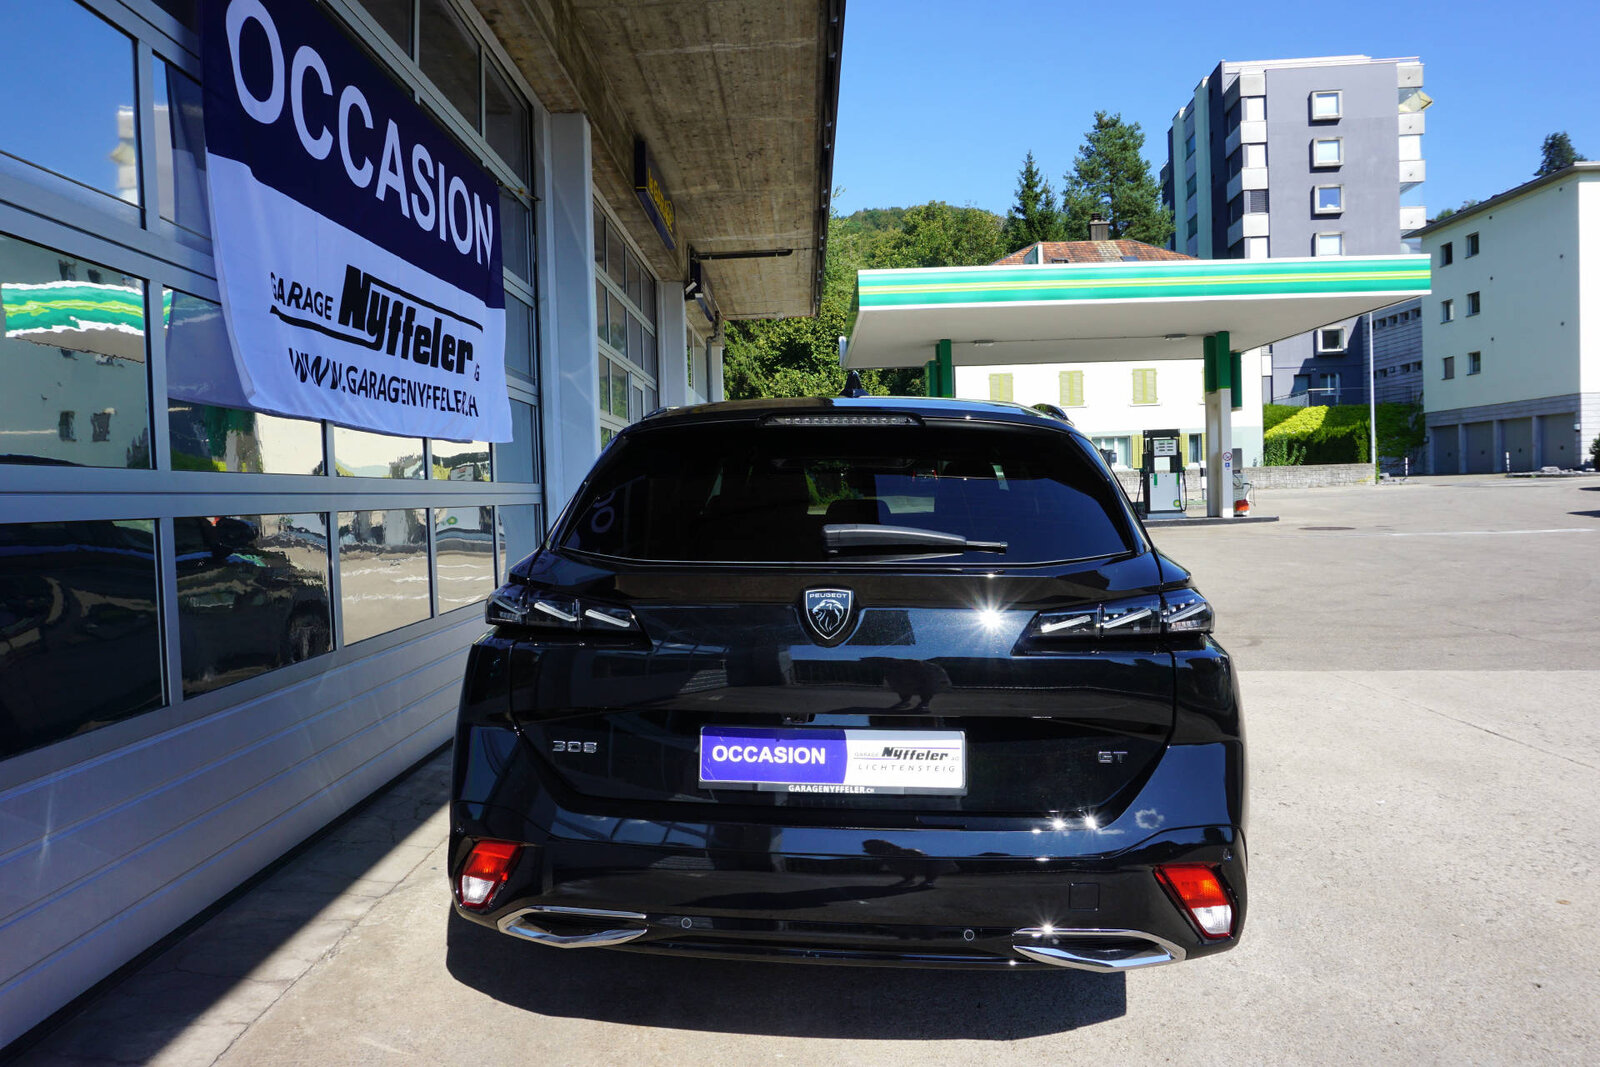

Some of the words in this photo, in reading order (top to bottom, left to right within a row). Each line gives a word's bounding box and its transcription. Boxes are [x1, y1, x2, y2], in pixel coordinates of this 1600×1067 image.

[225, 0, 494, 271] OCCASION
[270, 271, 334, 321] GARAGE
[338, 263, 474, 375] Nyffeler
[711, 745, 826, 765] OCCASION
[881, 746, 949, 762] Nyffeler
[1097, 751, 1128, 764] GT
[858, 763, 956, 773] LICHTENSTEIG
